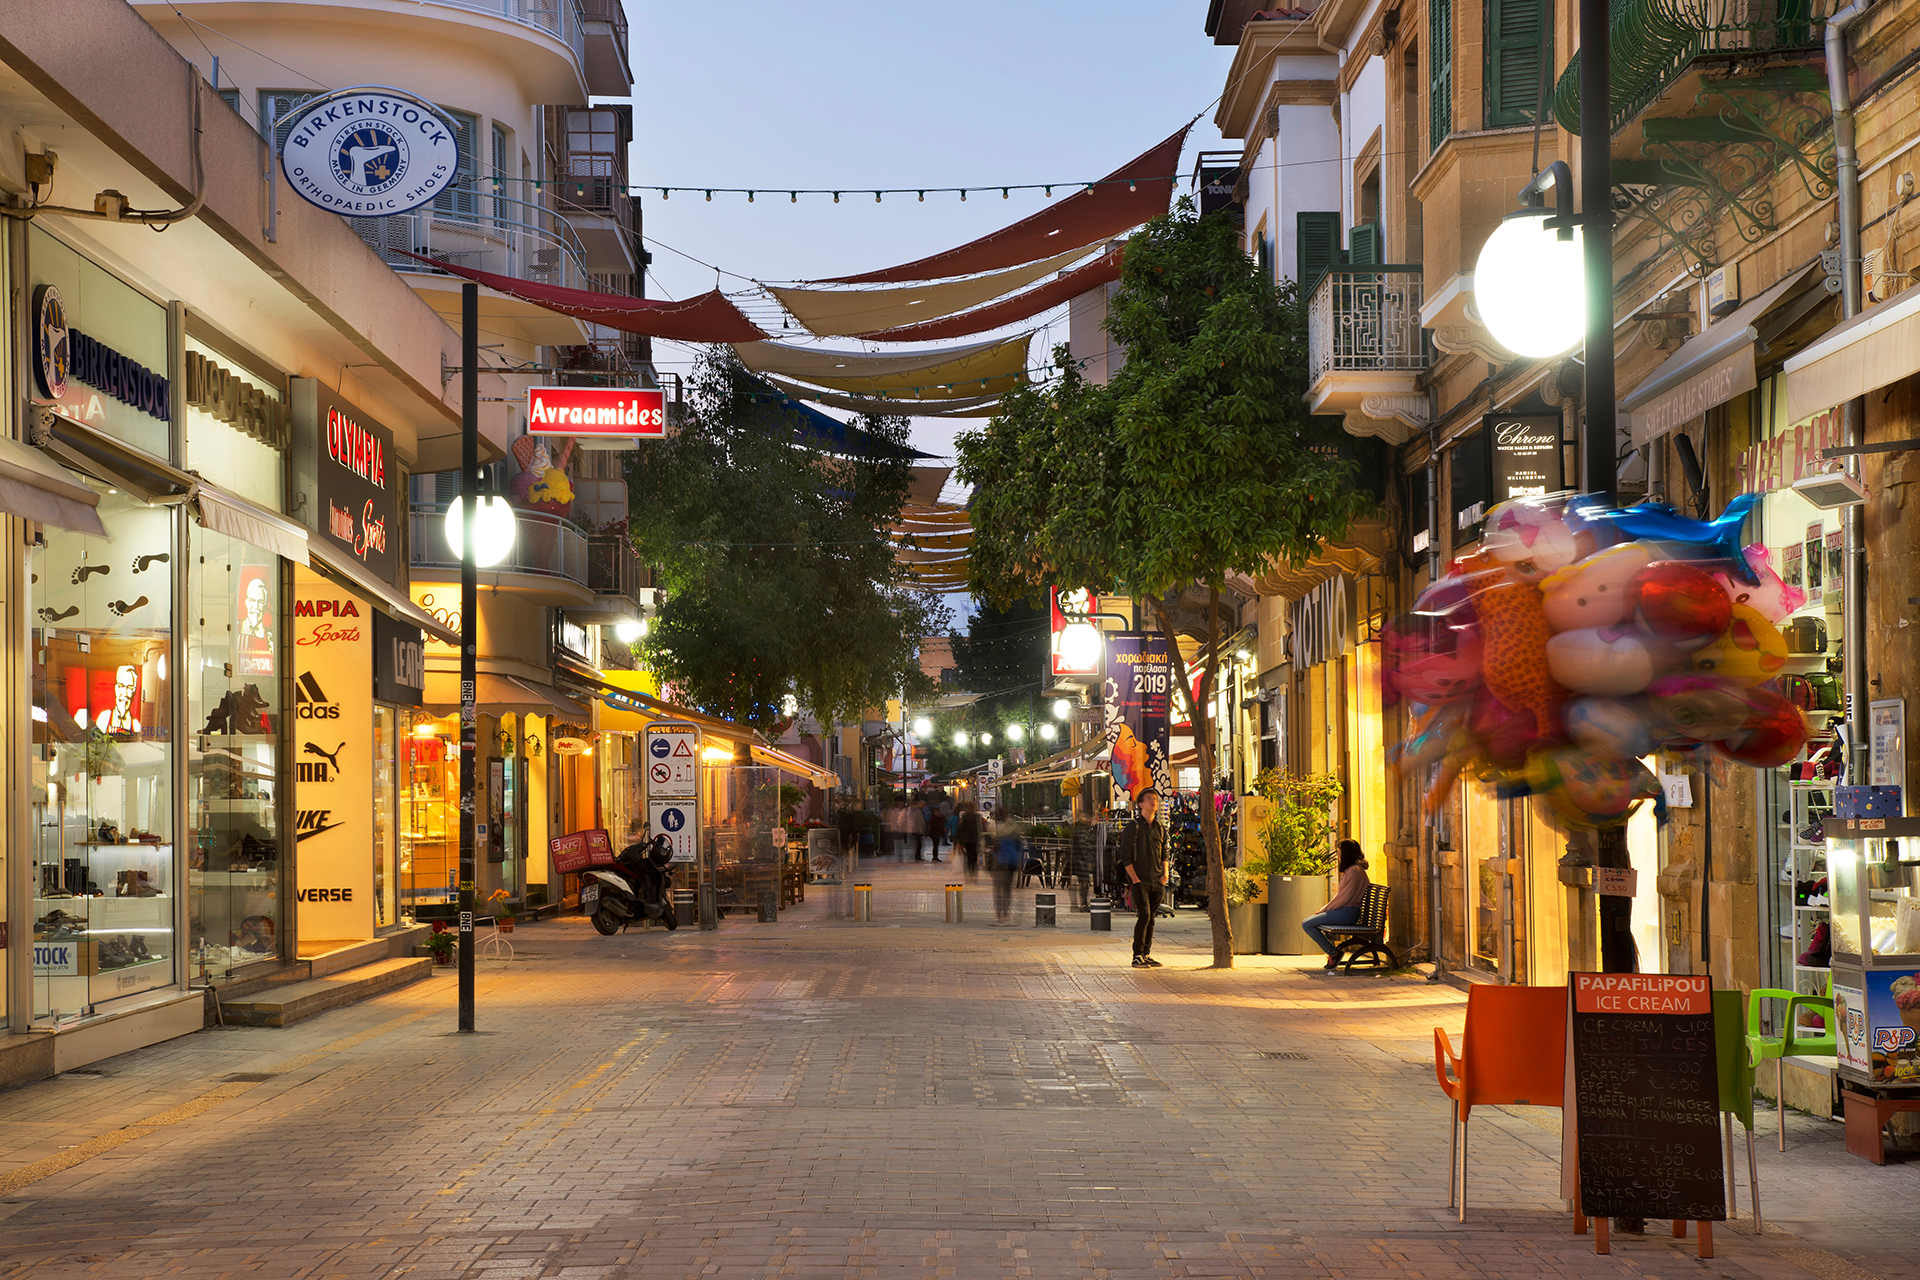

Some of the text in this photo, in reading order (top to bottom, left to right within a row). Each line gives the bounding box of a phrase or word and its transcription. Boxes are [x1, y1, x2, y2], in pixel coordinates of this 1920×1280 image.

[293, 100, 447, 148] BIRKENSTOCK
[336, 122, 403, 145] BIRKENSTOCK
[332, 159, 407, 194] MADE IN GERMANY
[293, 164, 447, 211] ORTHOPAEDIC SHOES
[72, 328, 171, 422] BIRKENSTOCK
[531, 397, 662, 426] Avraamides
[1645, 366, 1733, 439] SWEET BABE STORES
[1494, 421, 1555, 445] Chrono
[327, 405, 386, 490] OLYMPIA
[1735, 429, 1788, 497] SWEET
[354, 498, 386, 561] Sports
[1292, 572, 1348, 672] MOTIVO
[296, 623, 360, 647] Sports
[1116, 651, 1167, 666] χορωδιακή
[462, 682, 473, 700] BNE
[1133, 674, 1167, 693] 2019
[562, 840, 578, 850] KFC
[461, 913, 471, 931] BNE
[1596, 996, 1691, 1011] ICE CREAM
[1612, 1020, 1664, 1036] CREAM
[1875, 1028, 1915, 1051] P&P
[1579, 1057, 1637, 1071] ORANGE
[1581, 1070, 1638, 1082] CARROT
[1580, 1080, 1624, 1095] APPLE
[1581, 1106, 1628, 1119] BANANA
[1581, 1152, 1636, 1164] FRAPPE
[1581, 1165, 1635, 1178] CYPRUS
[1640, 1167, 1693, 1180] COFFEE
[1583, 1176, 1615, 1187] TEA
[1584, 1187, 1637, 1198] WATER
